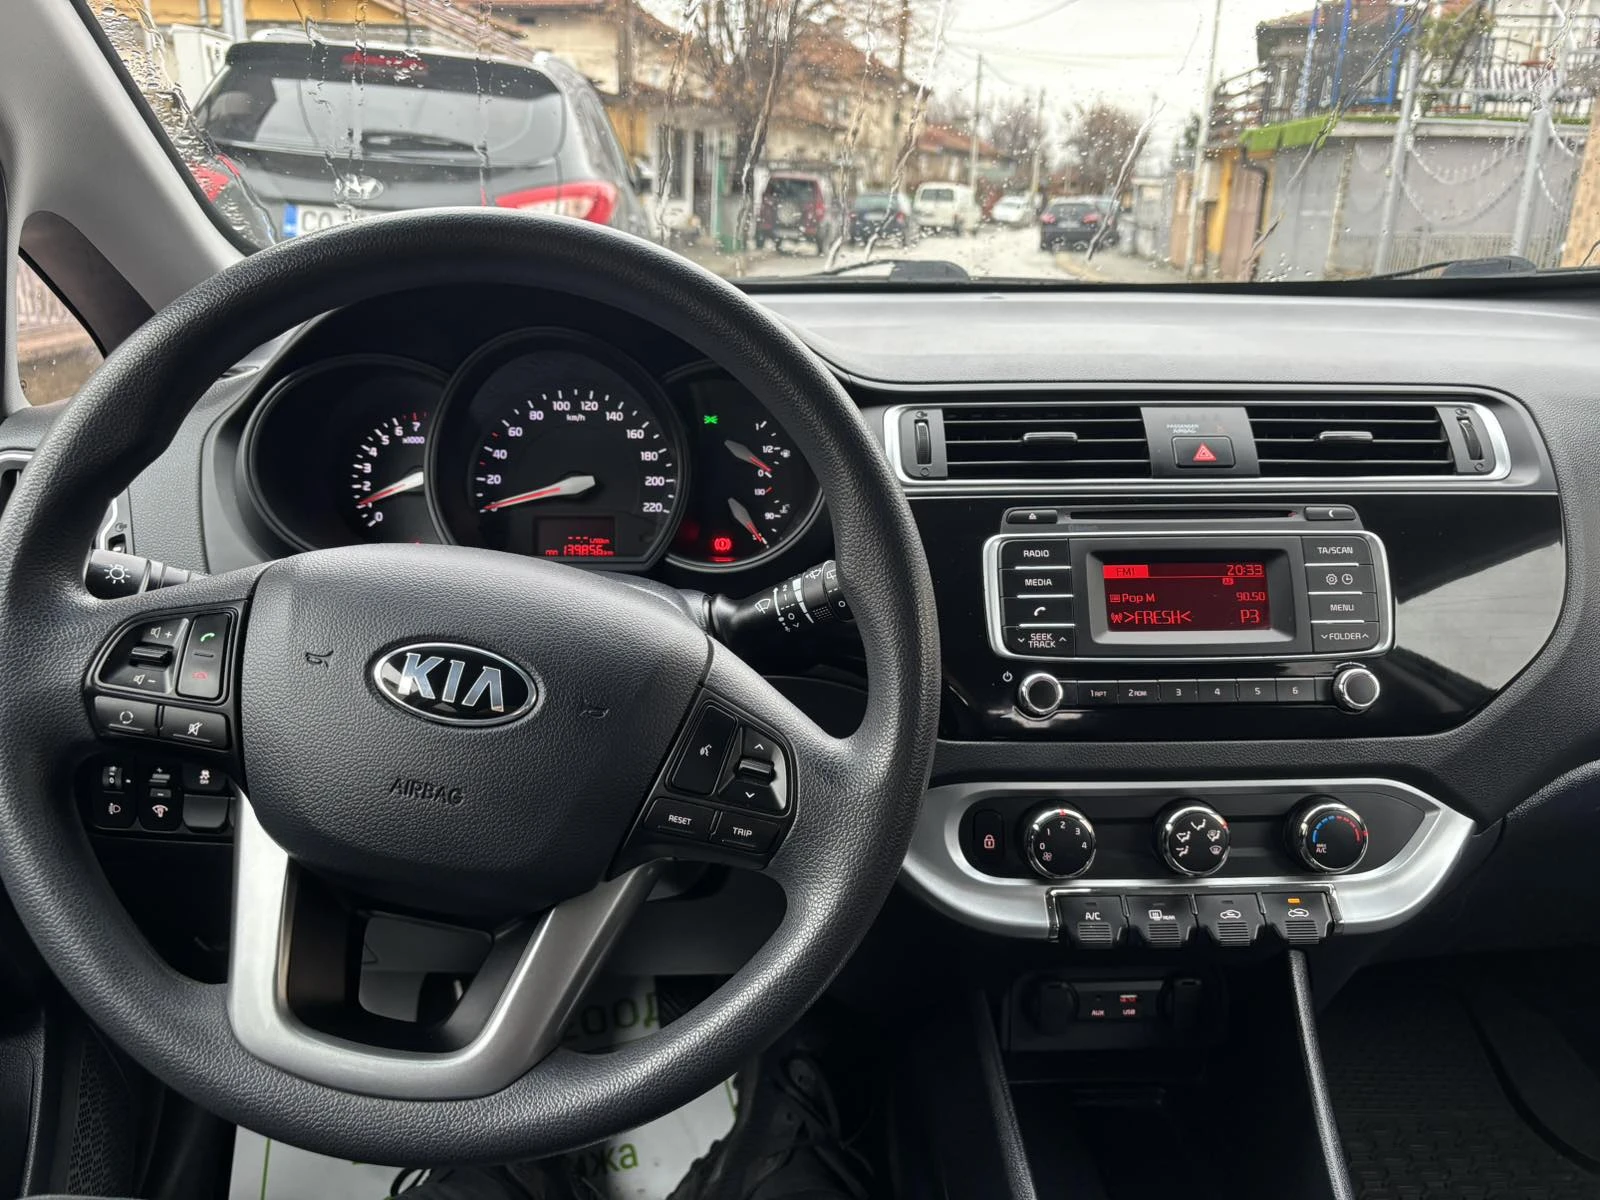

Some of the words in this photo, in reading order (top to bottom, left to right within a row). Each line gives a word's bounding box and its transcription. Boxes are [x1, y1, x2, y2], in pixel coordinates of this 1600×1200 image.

[552, 401, 570, 411] 100
[581, 401, 598, 411] 120
[529, 411, 544, 421] 80
[566, 414, 586, 422] km/h
[606, 412, 623, 422] 140
[395, 426, 404, 436] 6
[412, 422, 421, 432] 7
[508, 427, 522, 437] 60
[626, 429, 644, 439] 160
[381, 435, 390, 445] 5
[369, 447, 378, 457] 4
[762, 445, 773, 453] 1/2
[492, 450, 507, 459] 40
[641, 451, 658, 461] 180
[363, 463, 372, 473] 3
[758, 469, 764, 477] 0
[487, 475, 501, 484] 20
[645, 476, 665, 486] 200
[363, 481, 371, 491] 2
[643, 503, 663, 513] 220
[374, 511, 383, 521] 0
[765, 512, 774, 520] 90
[564, 544, 603, 556] 139856
[1317, 546, 1354, 554] TA/SCAN
[1227, 565, 1263, 575] 20:33
[1122, 593, 1143, 603] Pop
[1145, 593, 1155, 602] M
[1236, 592, 1266, 601] 90.50
[1240, 609, 1260, 623] P3
[1030, 633, 1053, 641] SEEK
[398, 653, 504, 712] KIA
[1176, 688, 1182, 696] 3
[1254, 687, 1261, 695] 5
[1292, 687, 1298, 695] 6
[390, 778, 464, 804] AIRBAG
[668, 814, 692, 825] RESET
[1060, 821, 1066, 829] 2
[732, 826, 753, 837] TRIP
[1039, 842, 1045, 850] 0
[1085, 911, 1101, 920] A/C
